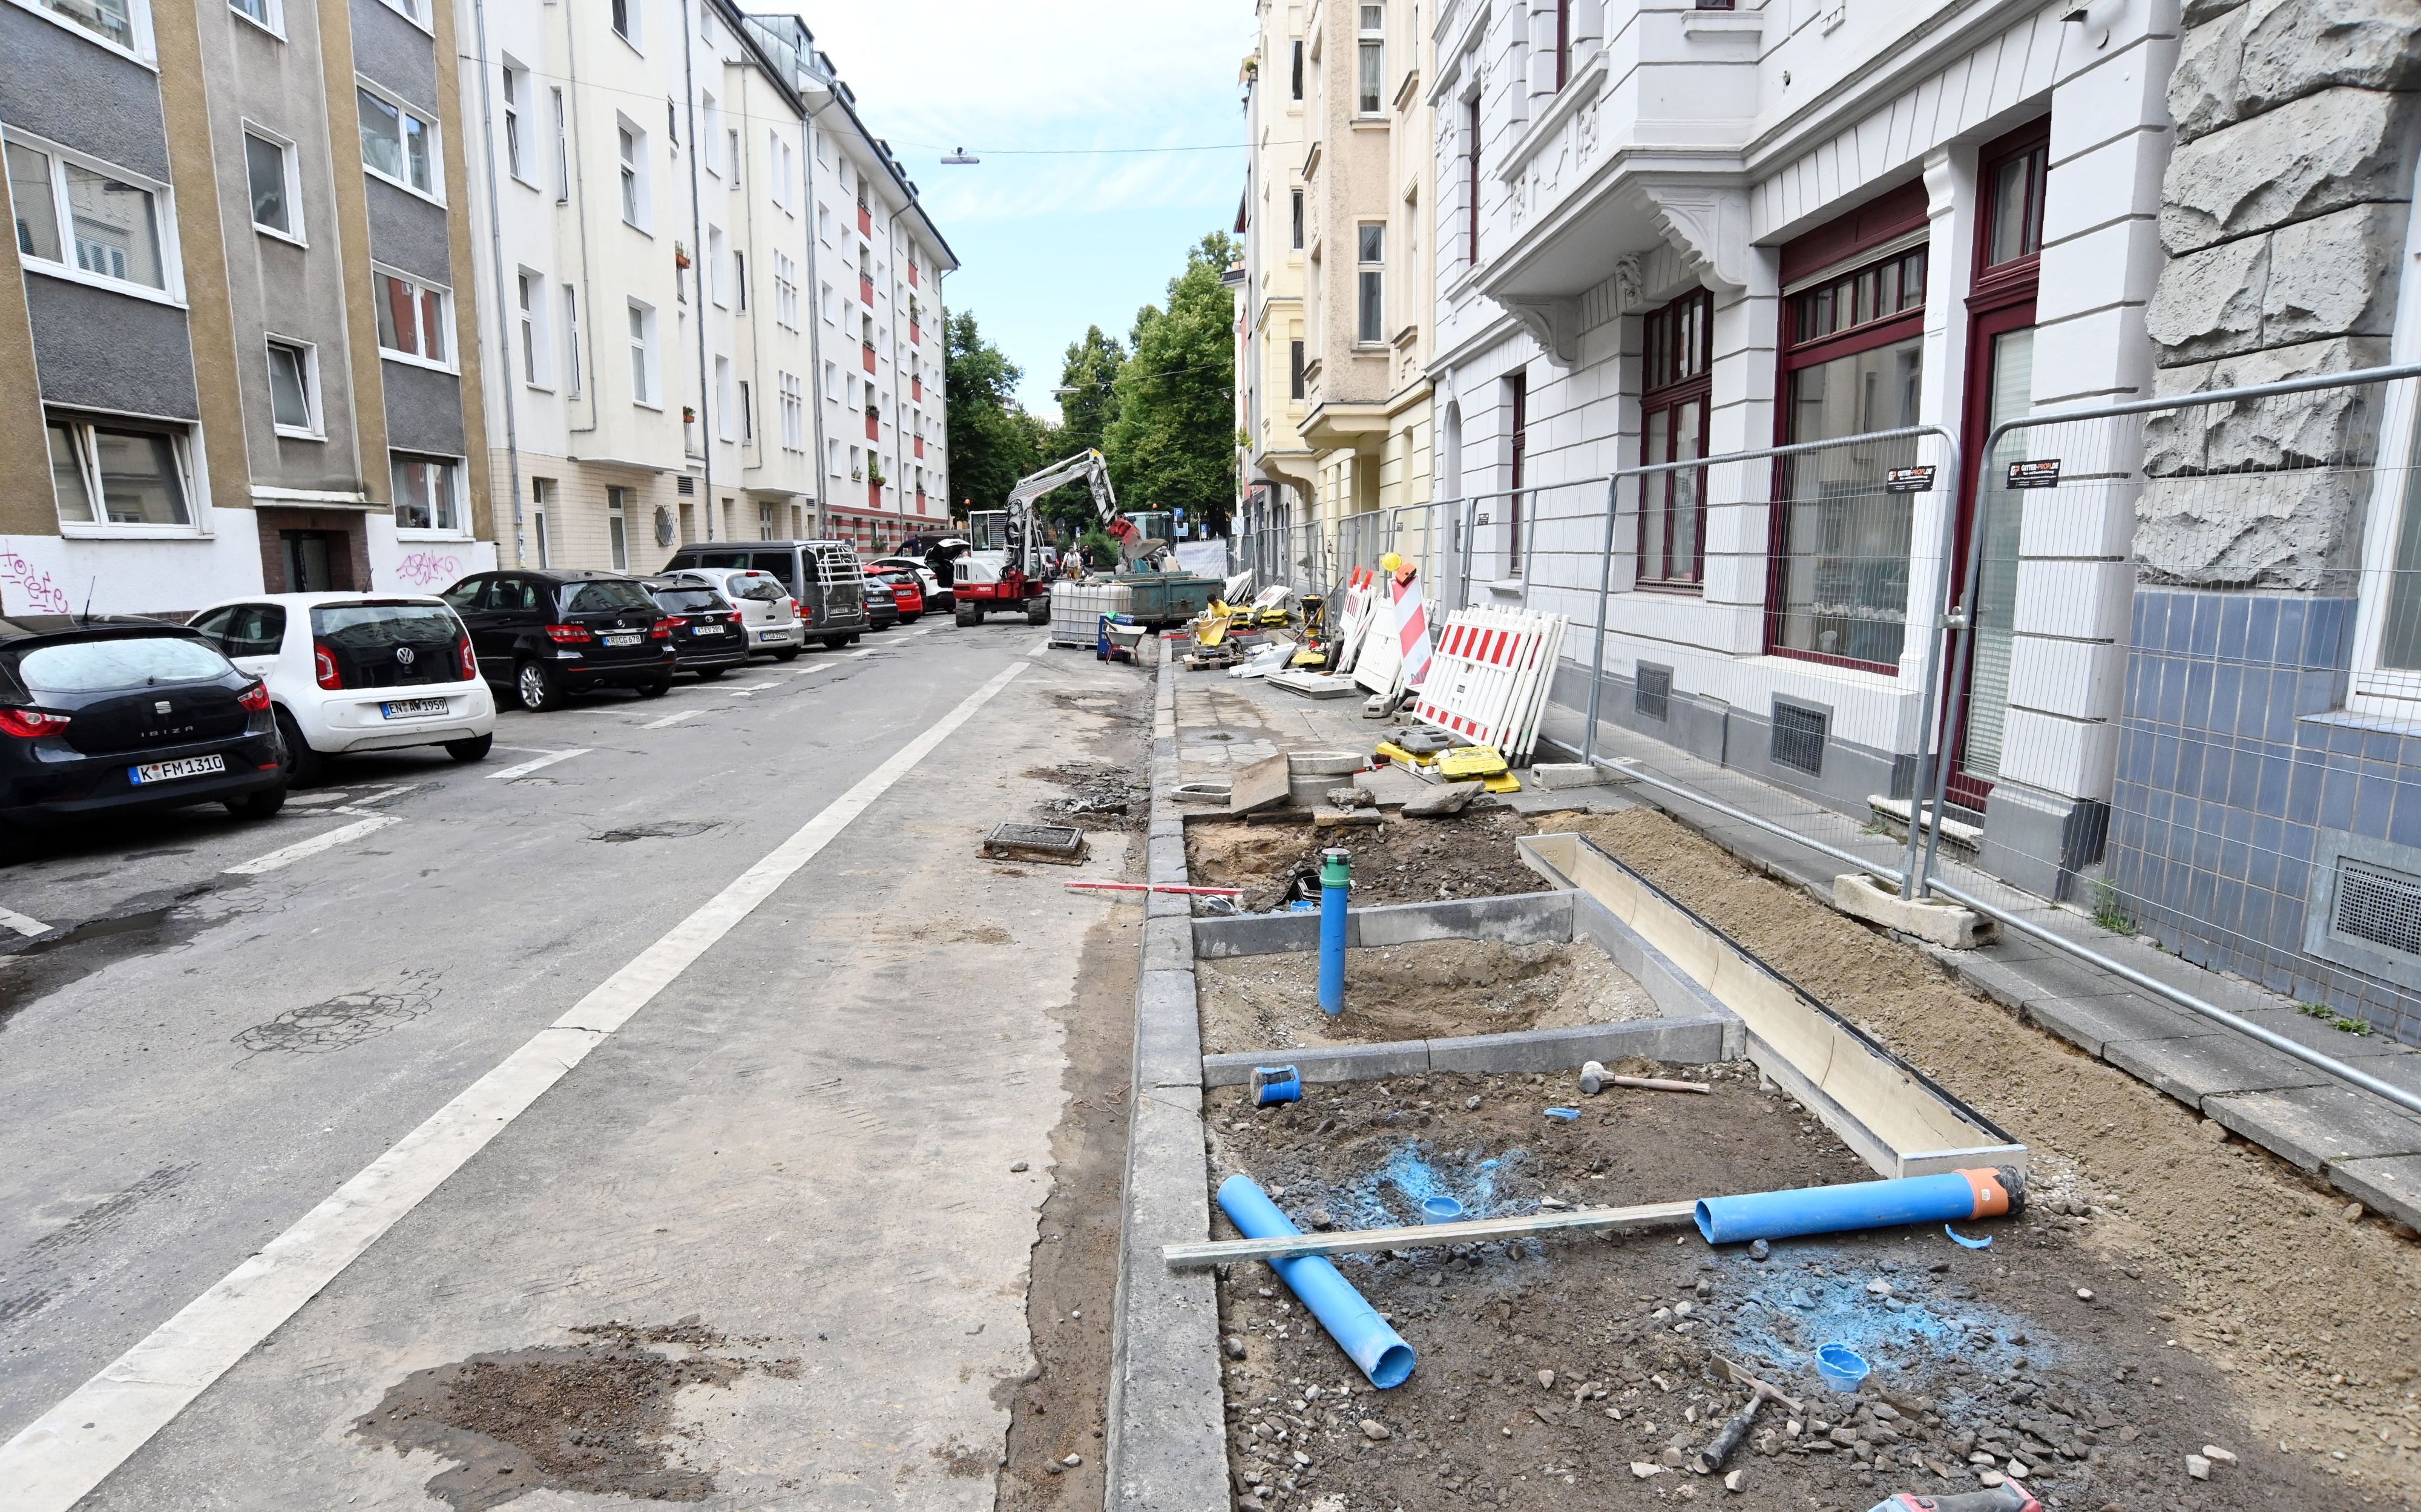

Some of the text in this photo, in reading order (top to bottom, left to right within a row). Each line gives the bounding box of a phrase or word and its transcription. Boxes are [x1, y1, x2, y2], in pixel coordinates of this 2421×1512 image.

[2021, 462, 2059, 472] GITTER-PROFI.DE
[389, 703, 403, 714] EN
[422, 700, 445, 711] 1959
[140, 726, 194, 737] IBIZA
[140, 757, 223, 781] K FM 1310
